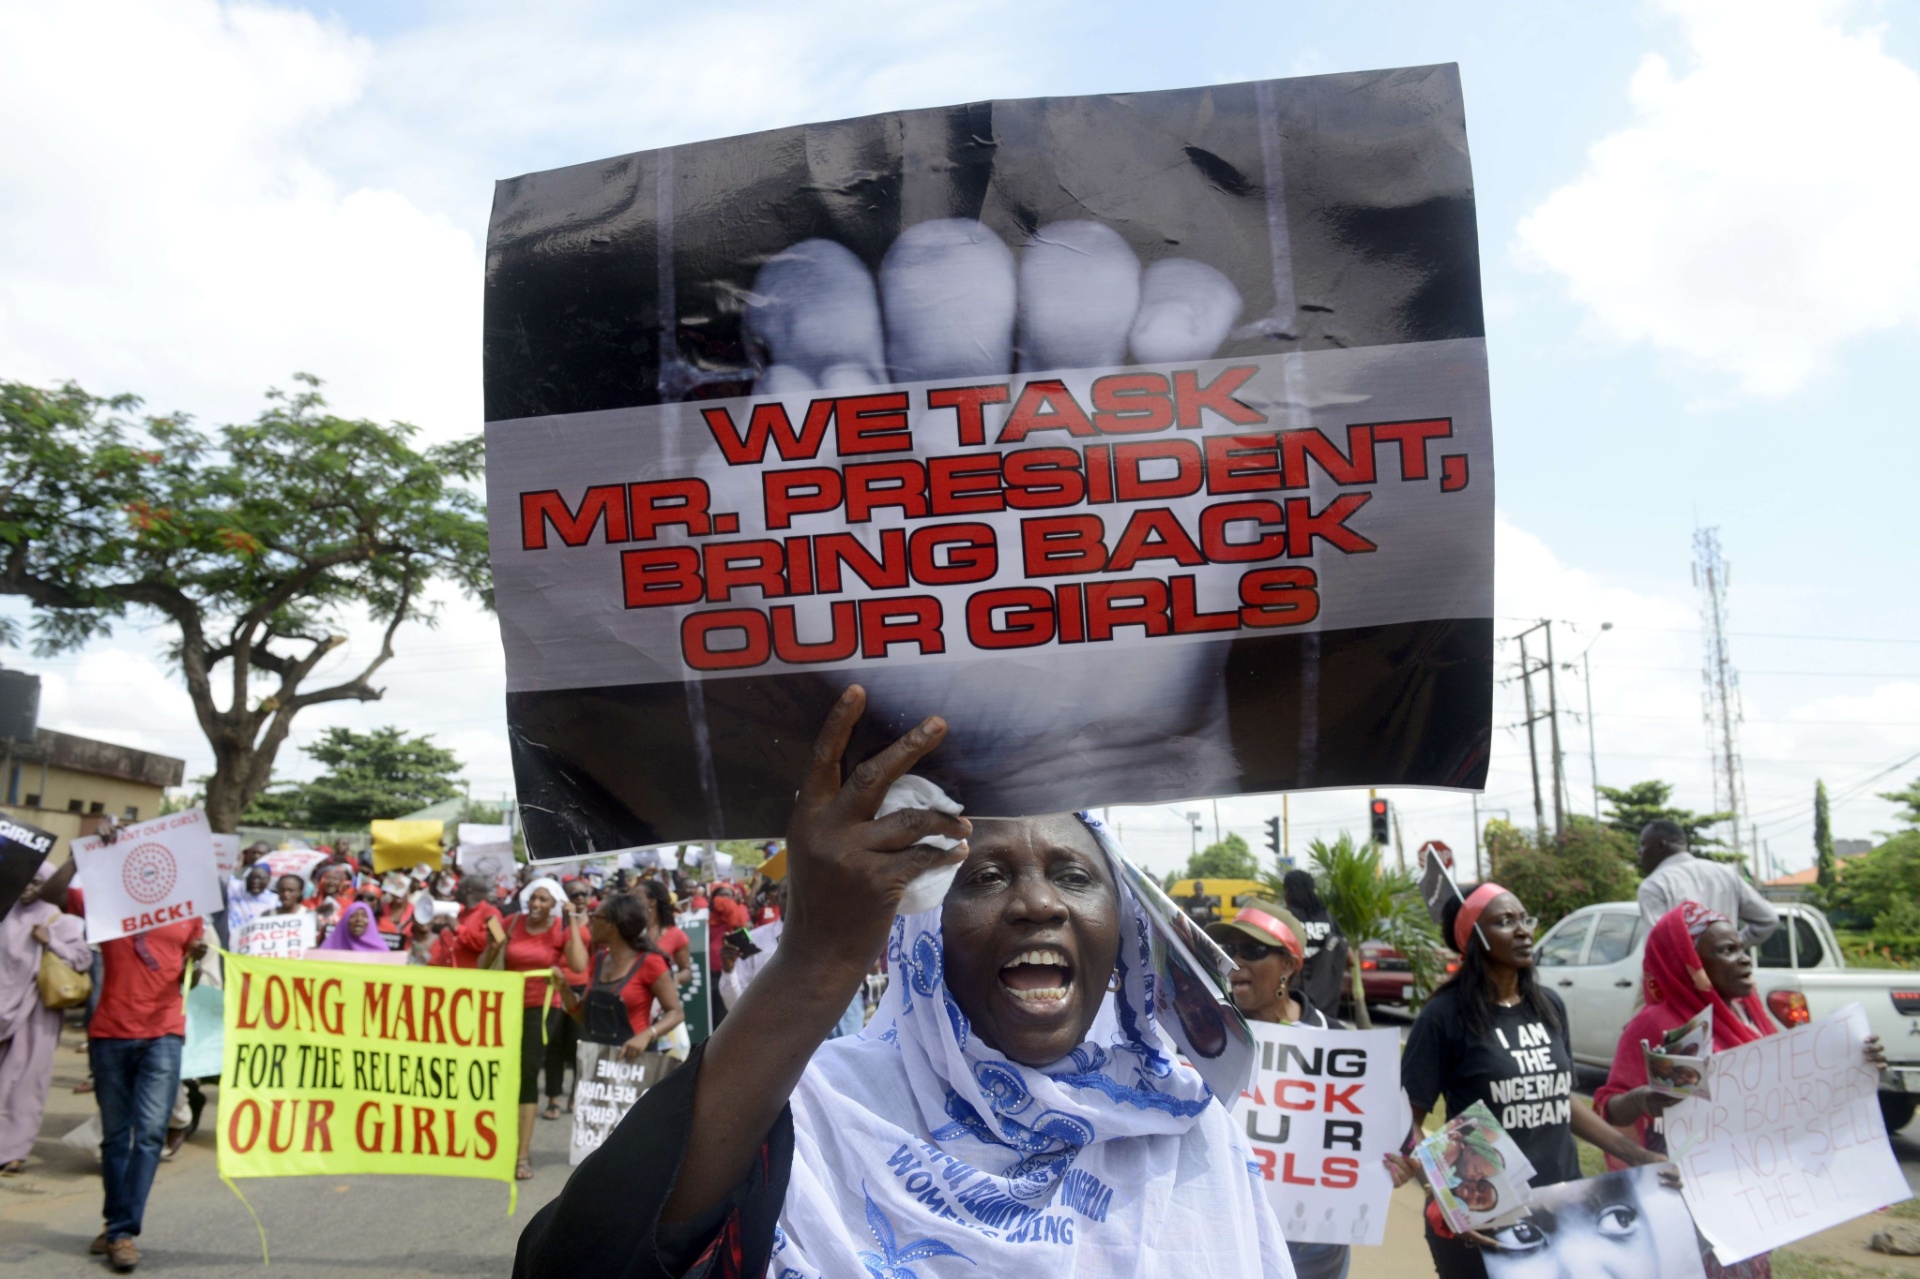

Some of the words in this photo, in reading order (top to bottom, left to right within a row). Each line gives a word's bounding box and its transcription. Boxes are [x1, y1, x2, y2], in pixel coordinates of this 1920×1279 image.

[701, 391, 913, 466] WE
[927, 365, 1268, 446] TASK
[520, 477, 739, 551] MR.
[762, 417, 1470, 530] PRESIDENT,
[620, 522, 998, 610] BRING
[1020, 491, 1378, 578] BACK
[681, 595, 946, 670] OUR
[966, 566, 1319, 651] GIRLS
[113, 828, 141, 845] ANT
[143, 822, 168, 837] OUR
[170, 812, 200, 829] GIRLS
[121, 901, 194, 933] BACK!
[235, 972, 346, 1036] LONG
[362, 981, 504, 1047] MARCH
[1495, 1027, 1510, 1050] I
[1517, 1022, 1551, 1048] AM
[231, 1043, 287, 1088] FOR
[297, 1045, 343, 1088] THE
[354, 1050, 458, 1100] RELEASE
[468, 1060, 499, 1100] OF
[597, 1059, 645, 1082] HOME
[1261, 1041, 1368, 1079] ING
[1511, 1047, 1557, 1074] THE
[228, 1099, 334, 1154] OUR
[355, 1101, 498, 1160] GIRLS
[1246, 1109, 1364, 1151] UR
[1502, 1099, 1572, 1129] DREAM
[1252, 1147, 1359, 1189] RLS
[1680, 1150, 1711, 1205] IF
[1731, 1125, 1795, 1186] NOT
[1805, 1104, 1885, 1156] SELL
[1061, 1169, 1114, 1223] NIGERIA
[1734, 1163, 1842, 1232] THEM
